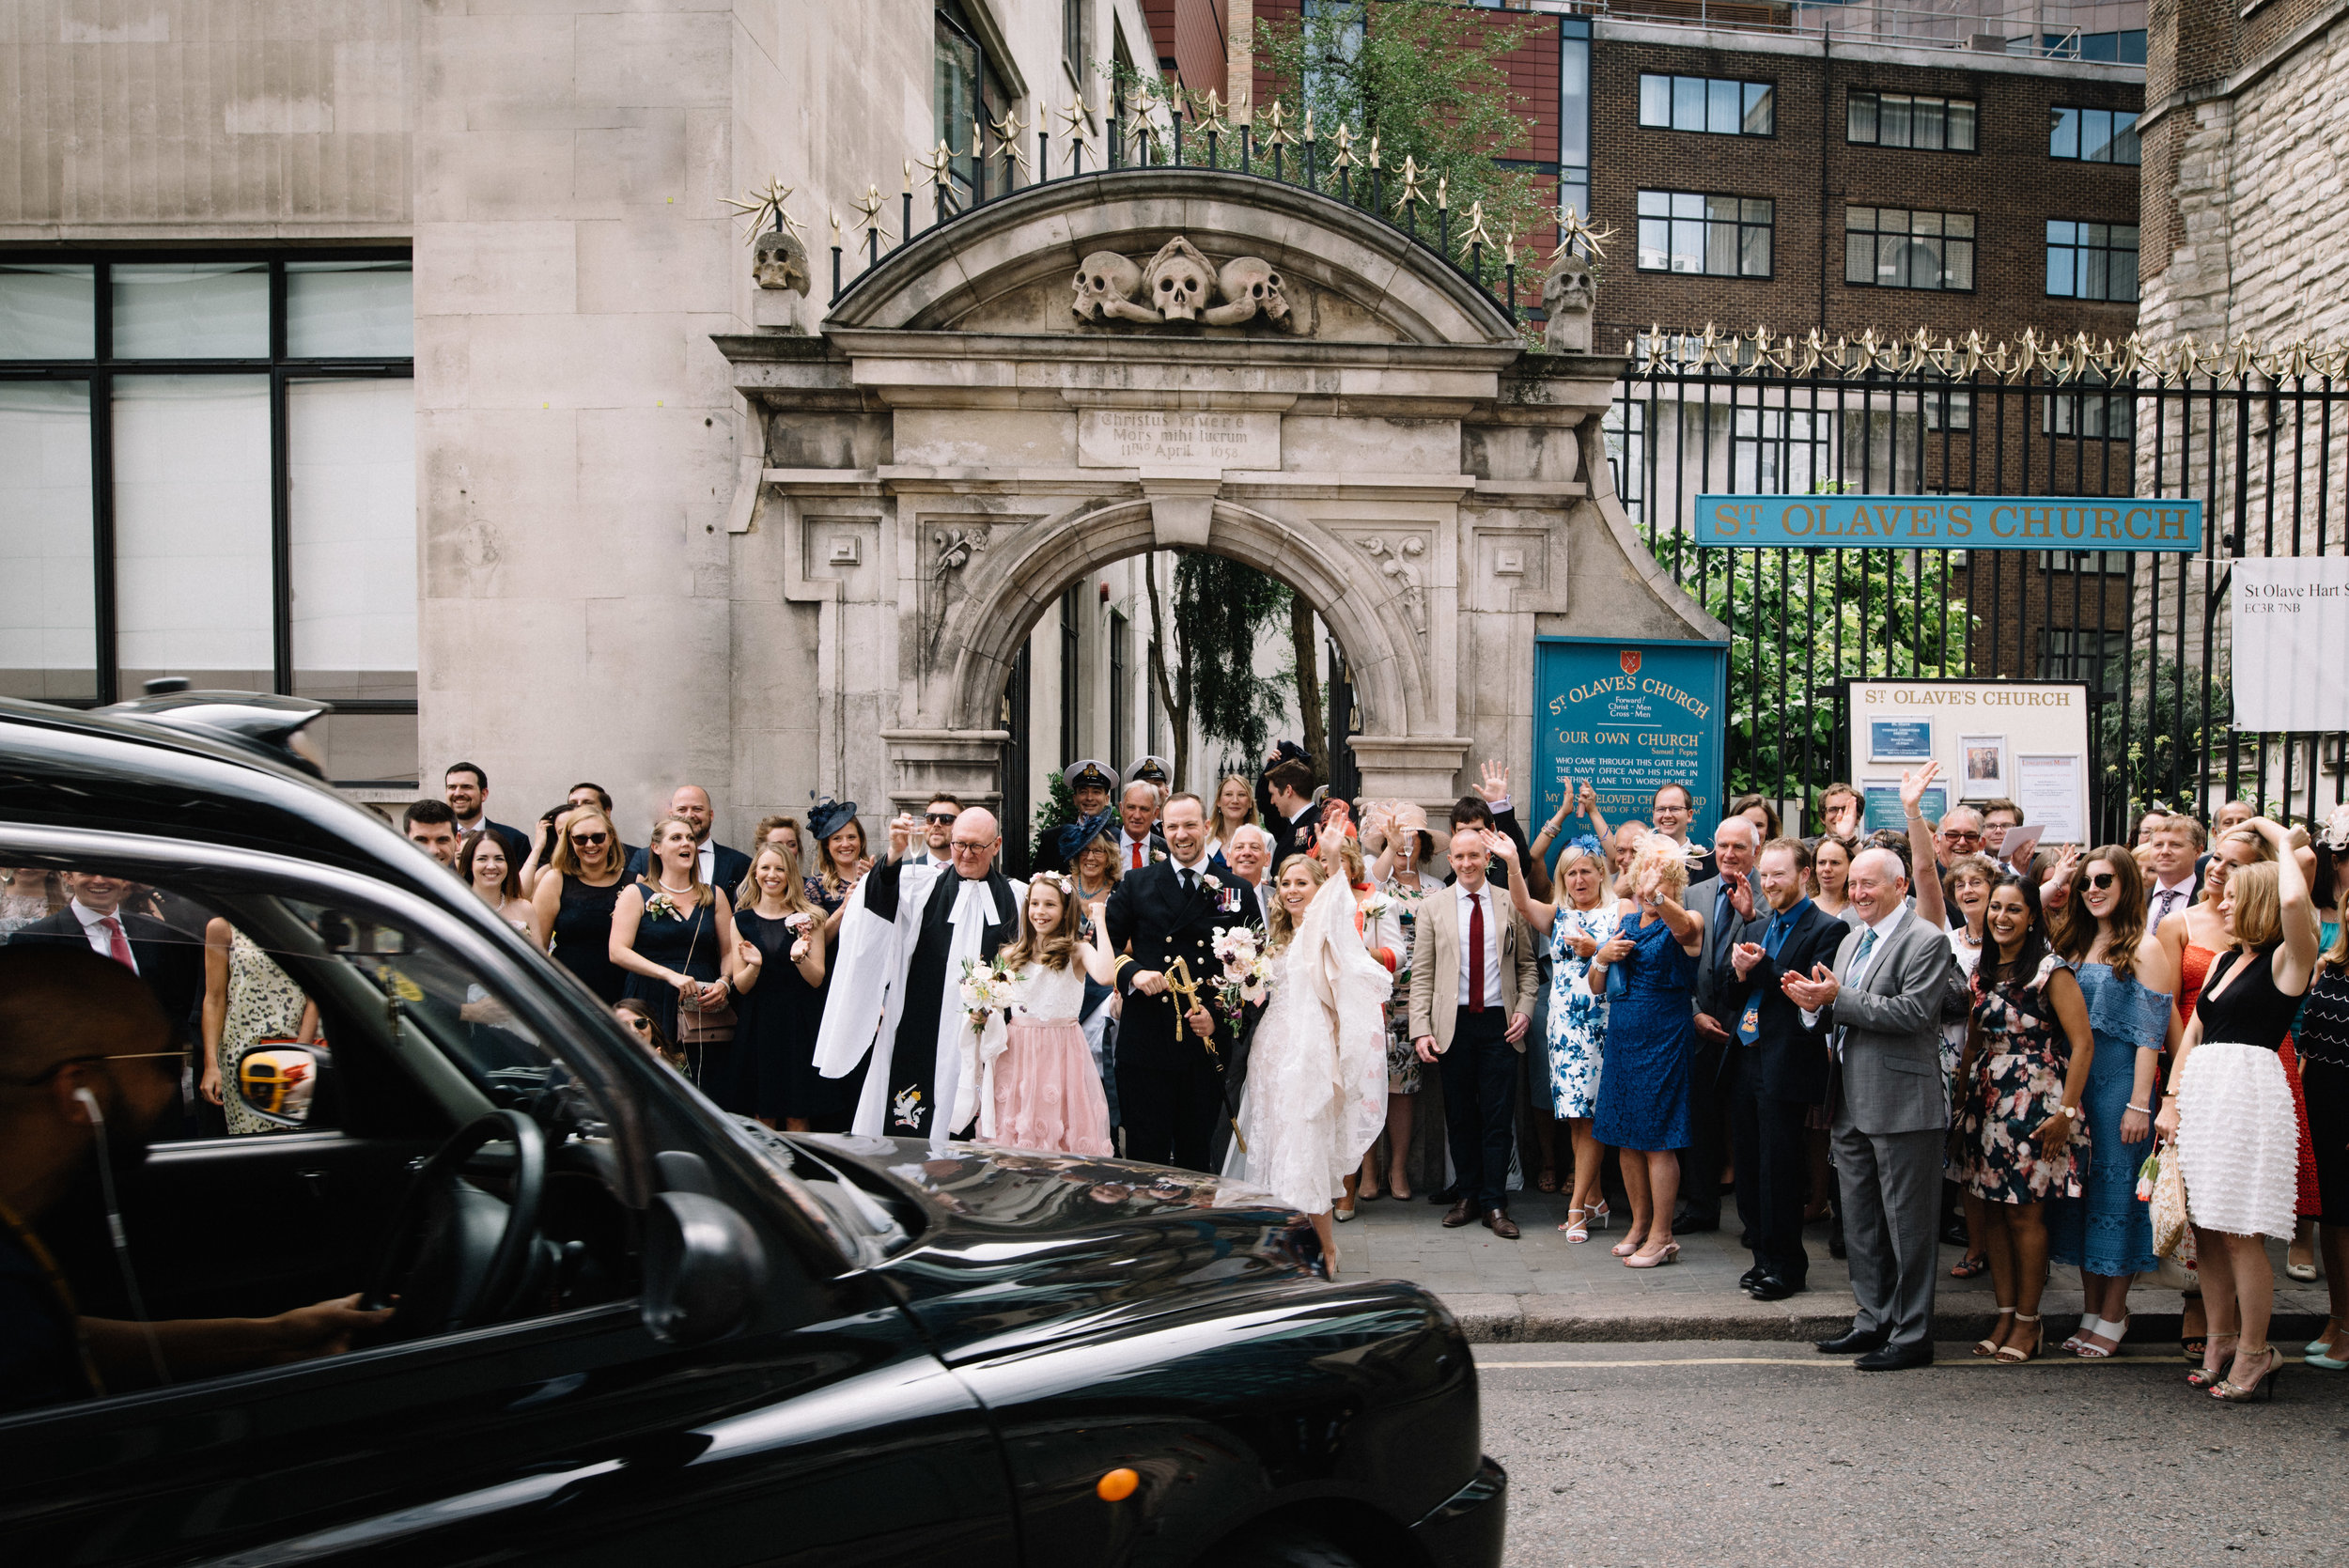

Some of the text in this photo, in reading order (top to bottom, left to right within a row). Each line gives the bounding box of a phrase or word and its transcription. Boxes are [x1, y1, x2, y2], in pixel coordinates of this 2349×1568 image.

[1101, 413, 1244, 427] Christus vivere
[1113, 429, 1247, 443] Mors mihi lucrum
[1211, 445, 1238, 459] 1658
[1781, 504, 1972, 537] OLAVE'S
[1989, 506, 2189, 540] CHURCH
[2245, 584, 2259, 598] St
[2263, 583, 2304, 598] Olave
[2310, 583, 2340, 597] Hart
[2245, 603, 2300, 613] EC3R 7NB
[1569, 675, 1637, 703] OLAVE'S
[1642, 678, 1710, 720] CHURCH
[1894, 691, 1976, 705] OLAVE'S
[1983, 691, 2070, 706] CHURCH
[1595, 732, 1629, 745] OWN
